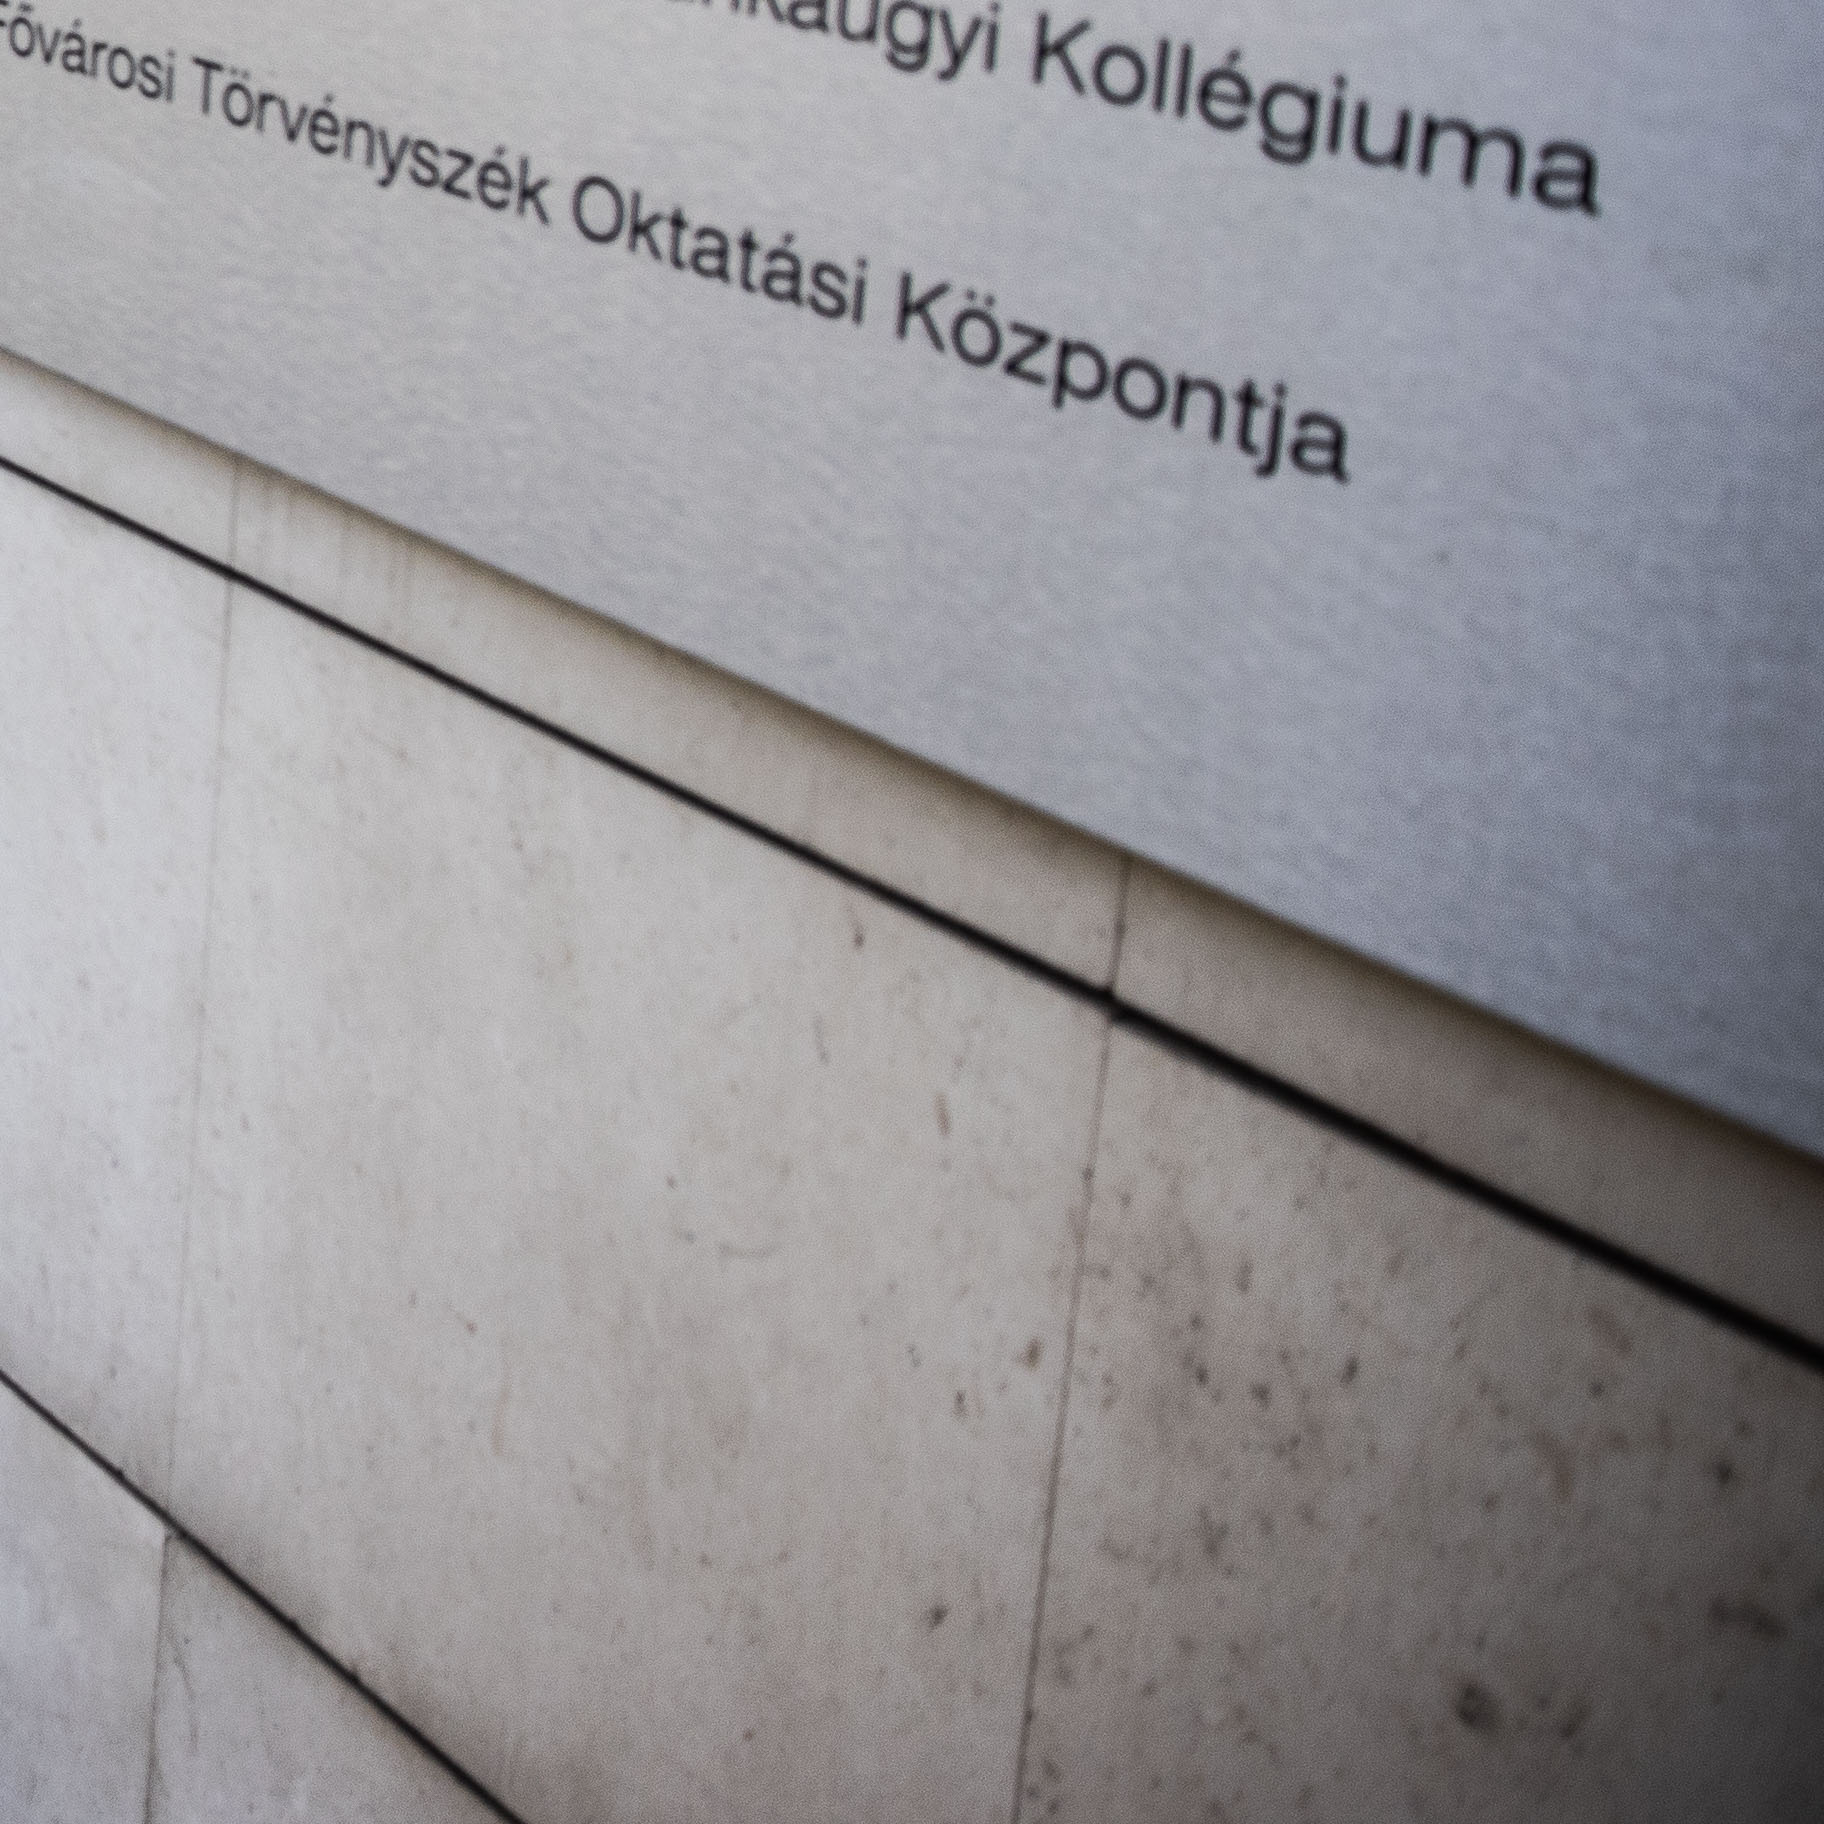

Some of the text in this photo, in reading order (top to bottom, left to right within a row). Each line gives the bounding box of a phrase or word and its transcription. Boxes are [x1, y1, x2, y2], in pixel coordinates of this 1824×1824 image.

[191, 55, 551, 227] Törvényszék
[571, 174, 868, 327] Oktatási
[894, 270, 1351, 486] Központja
[1031, 10, 1602, 219] Kollégiuma
